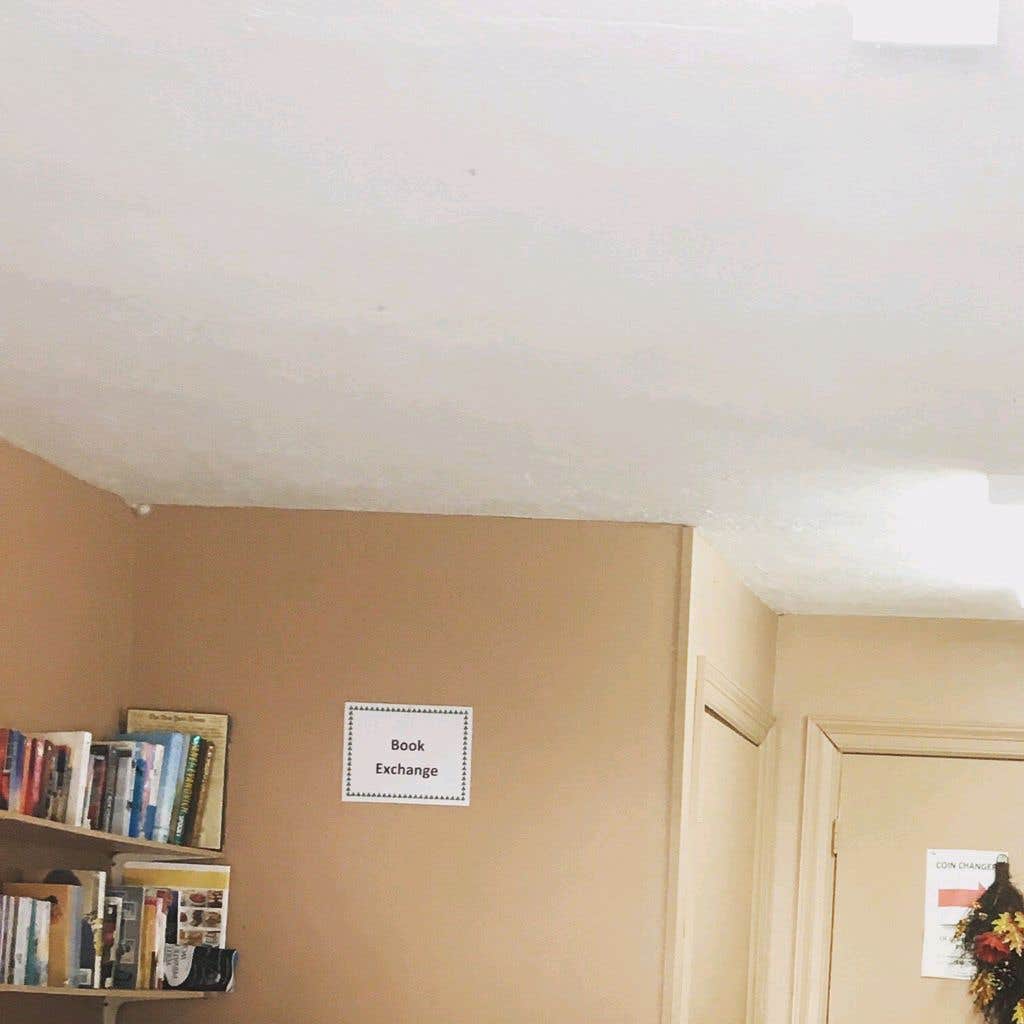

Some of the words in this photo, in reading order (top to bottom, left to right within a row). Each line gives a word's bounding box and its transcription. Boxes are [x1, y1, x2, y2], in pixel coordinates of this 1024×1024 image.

[391, 739, 425, 751] Book
[375, 763, 439, 779] Exchange
[936, 862, 956, 870] COIN
